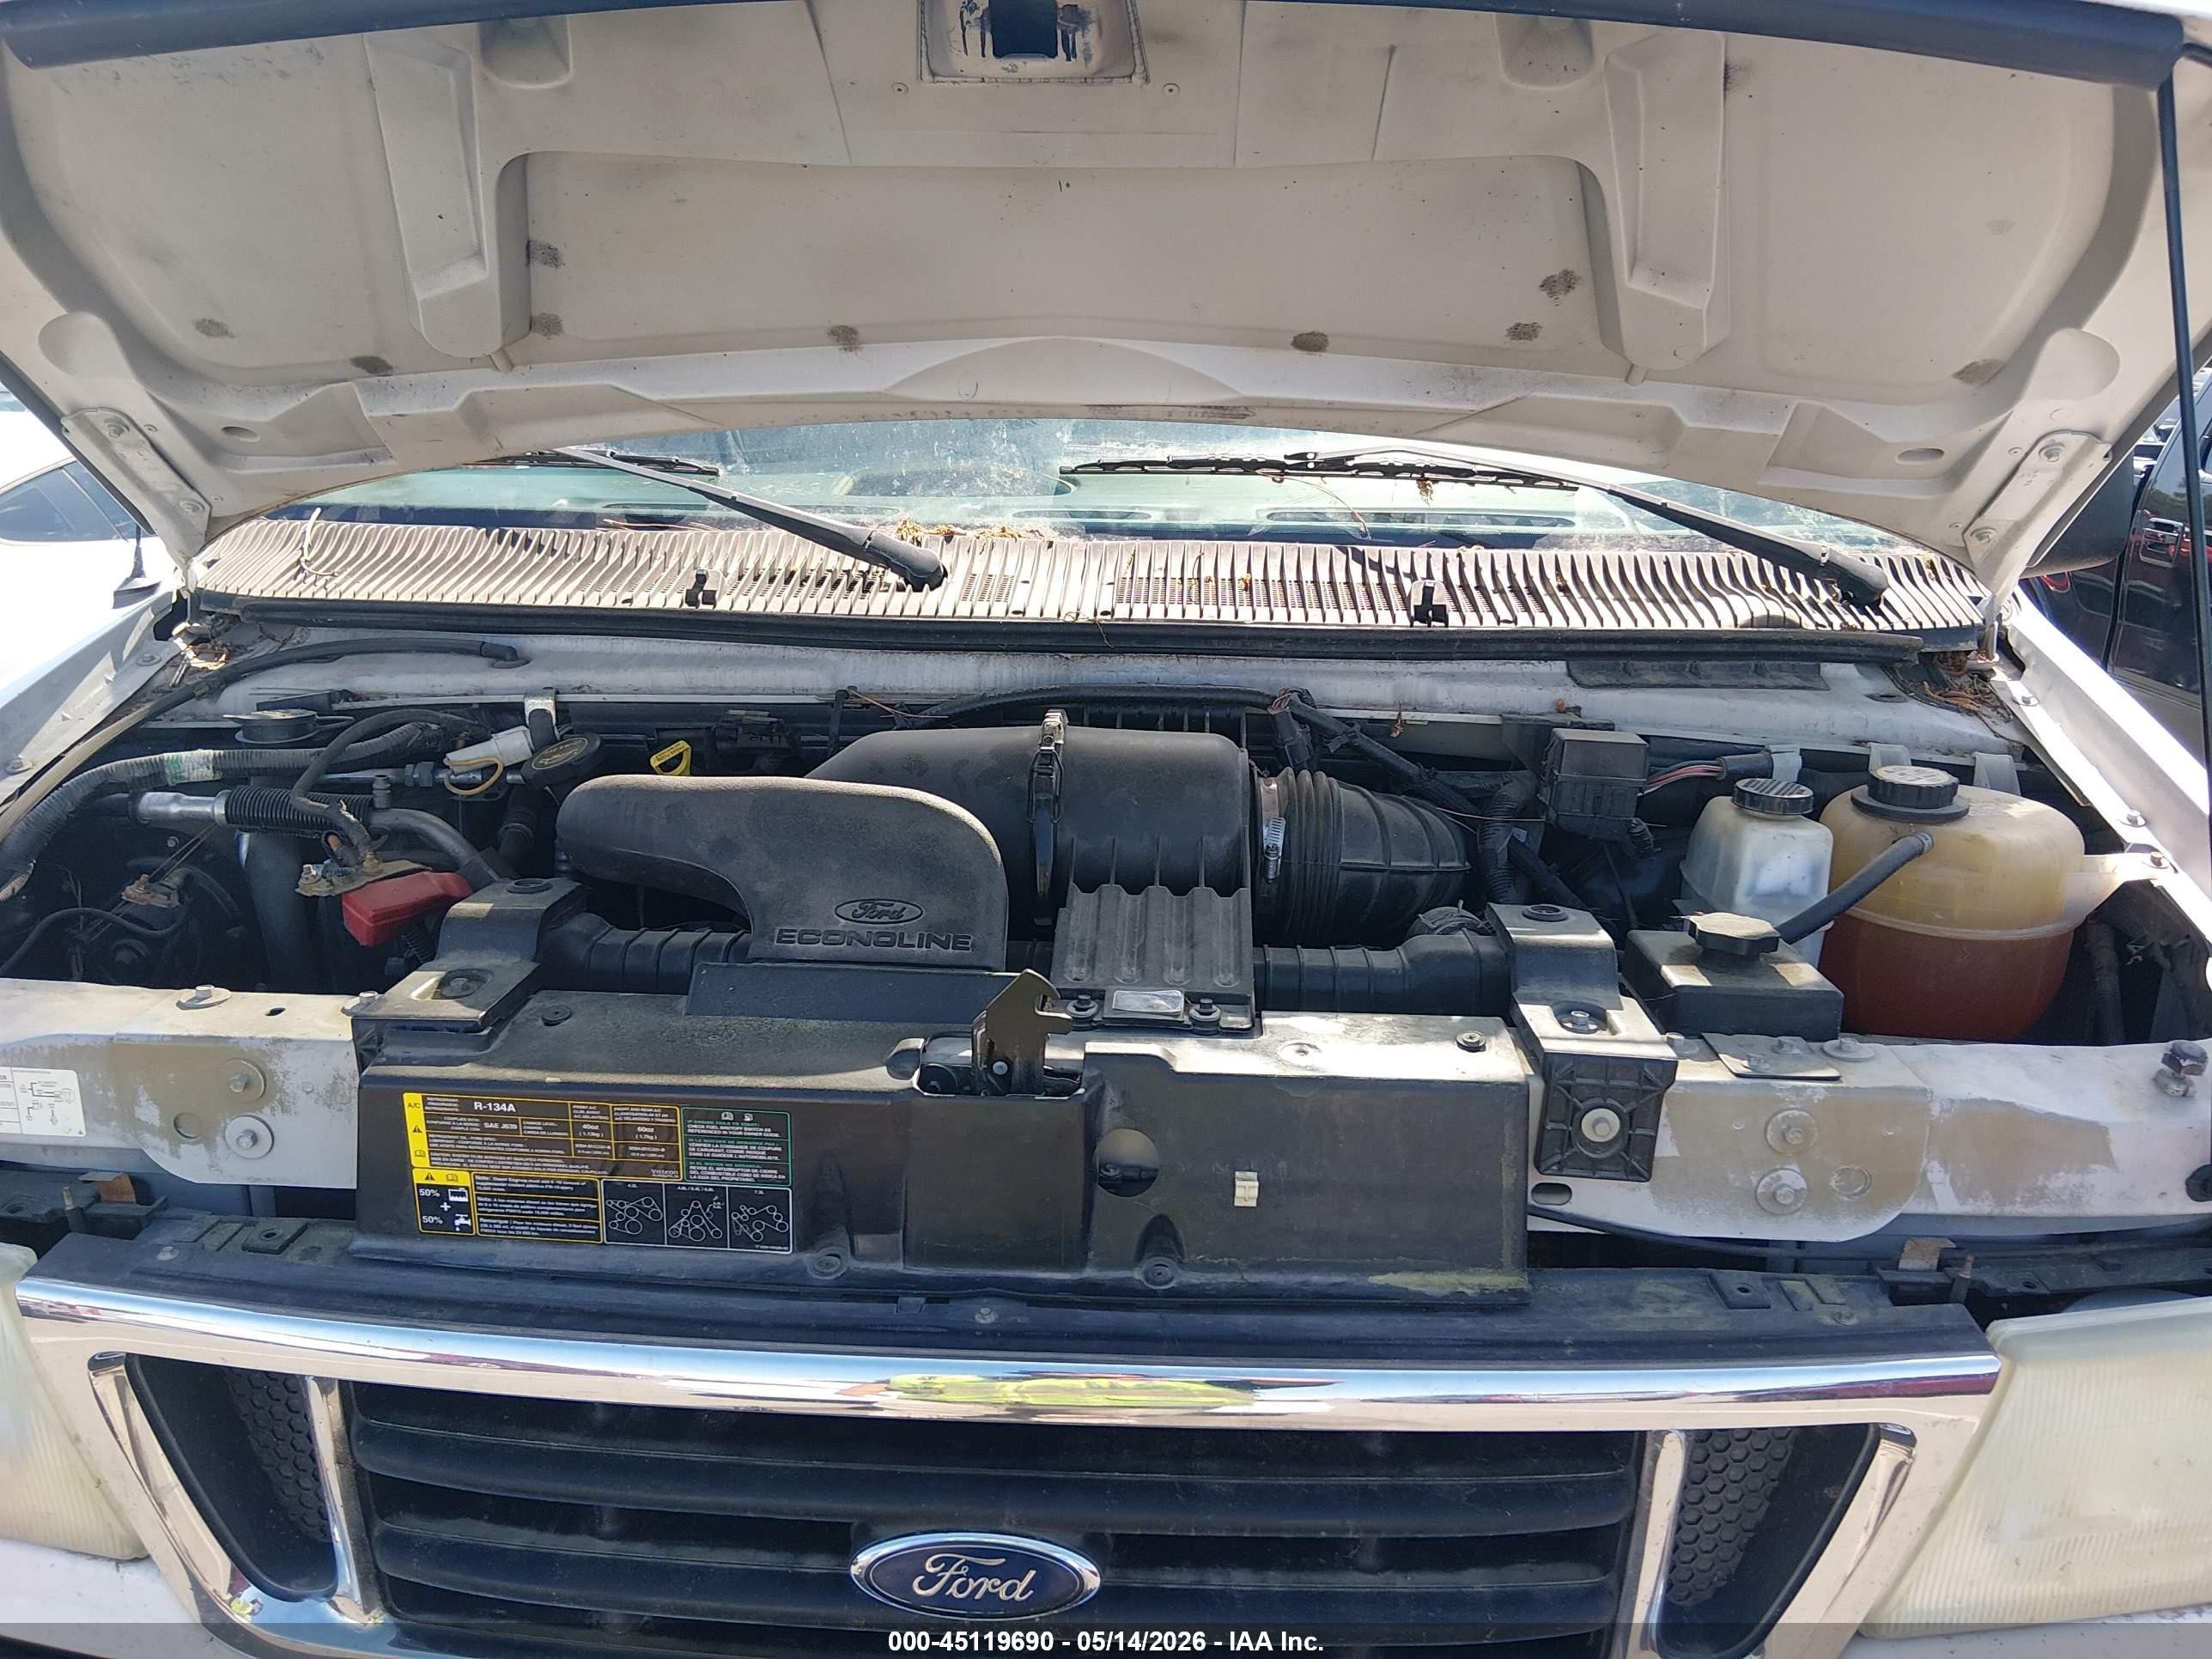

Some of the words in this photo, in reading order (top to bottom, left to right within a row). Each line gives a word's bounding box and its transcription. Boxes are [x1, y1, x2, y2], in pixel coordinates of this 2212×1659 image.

[852, 902, 907, 920] Ford
[776, 929, 972, 951] ECONOLINE
[474, 1102, 515, 1112] R-134A
[419, 1188, 441, 1197] 50%
[422, 1216, 443, 1224] 50%
[913, 1553, 1036, 1601] Ford
